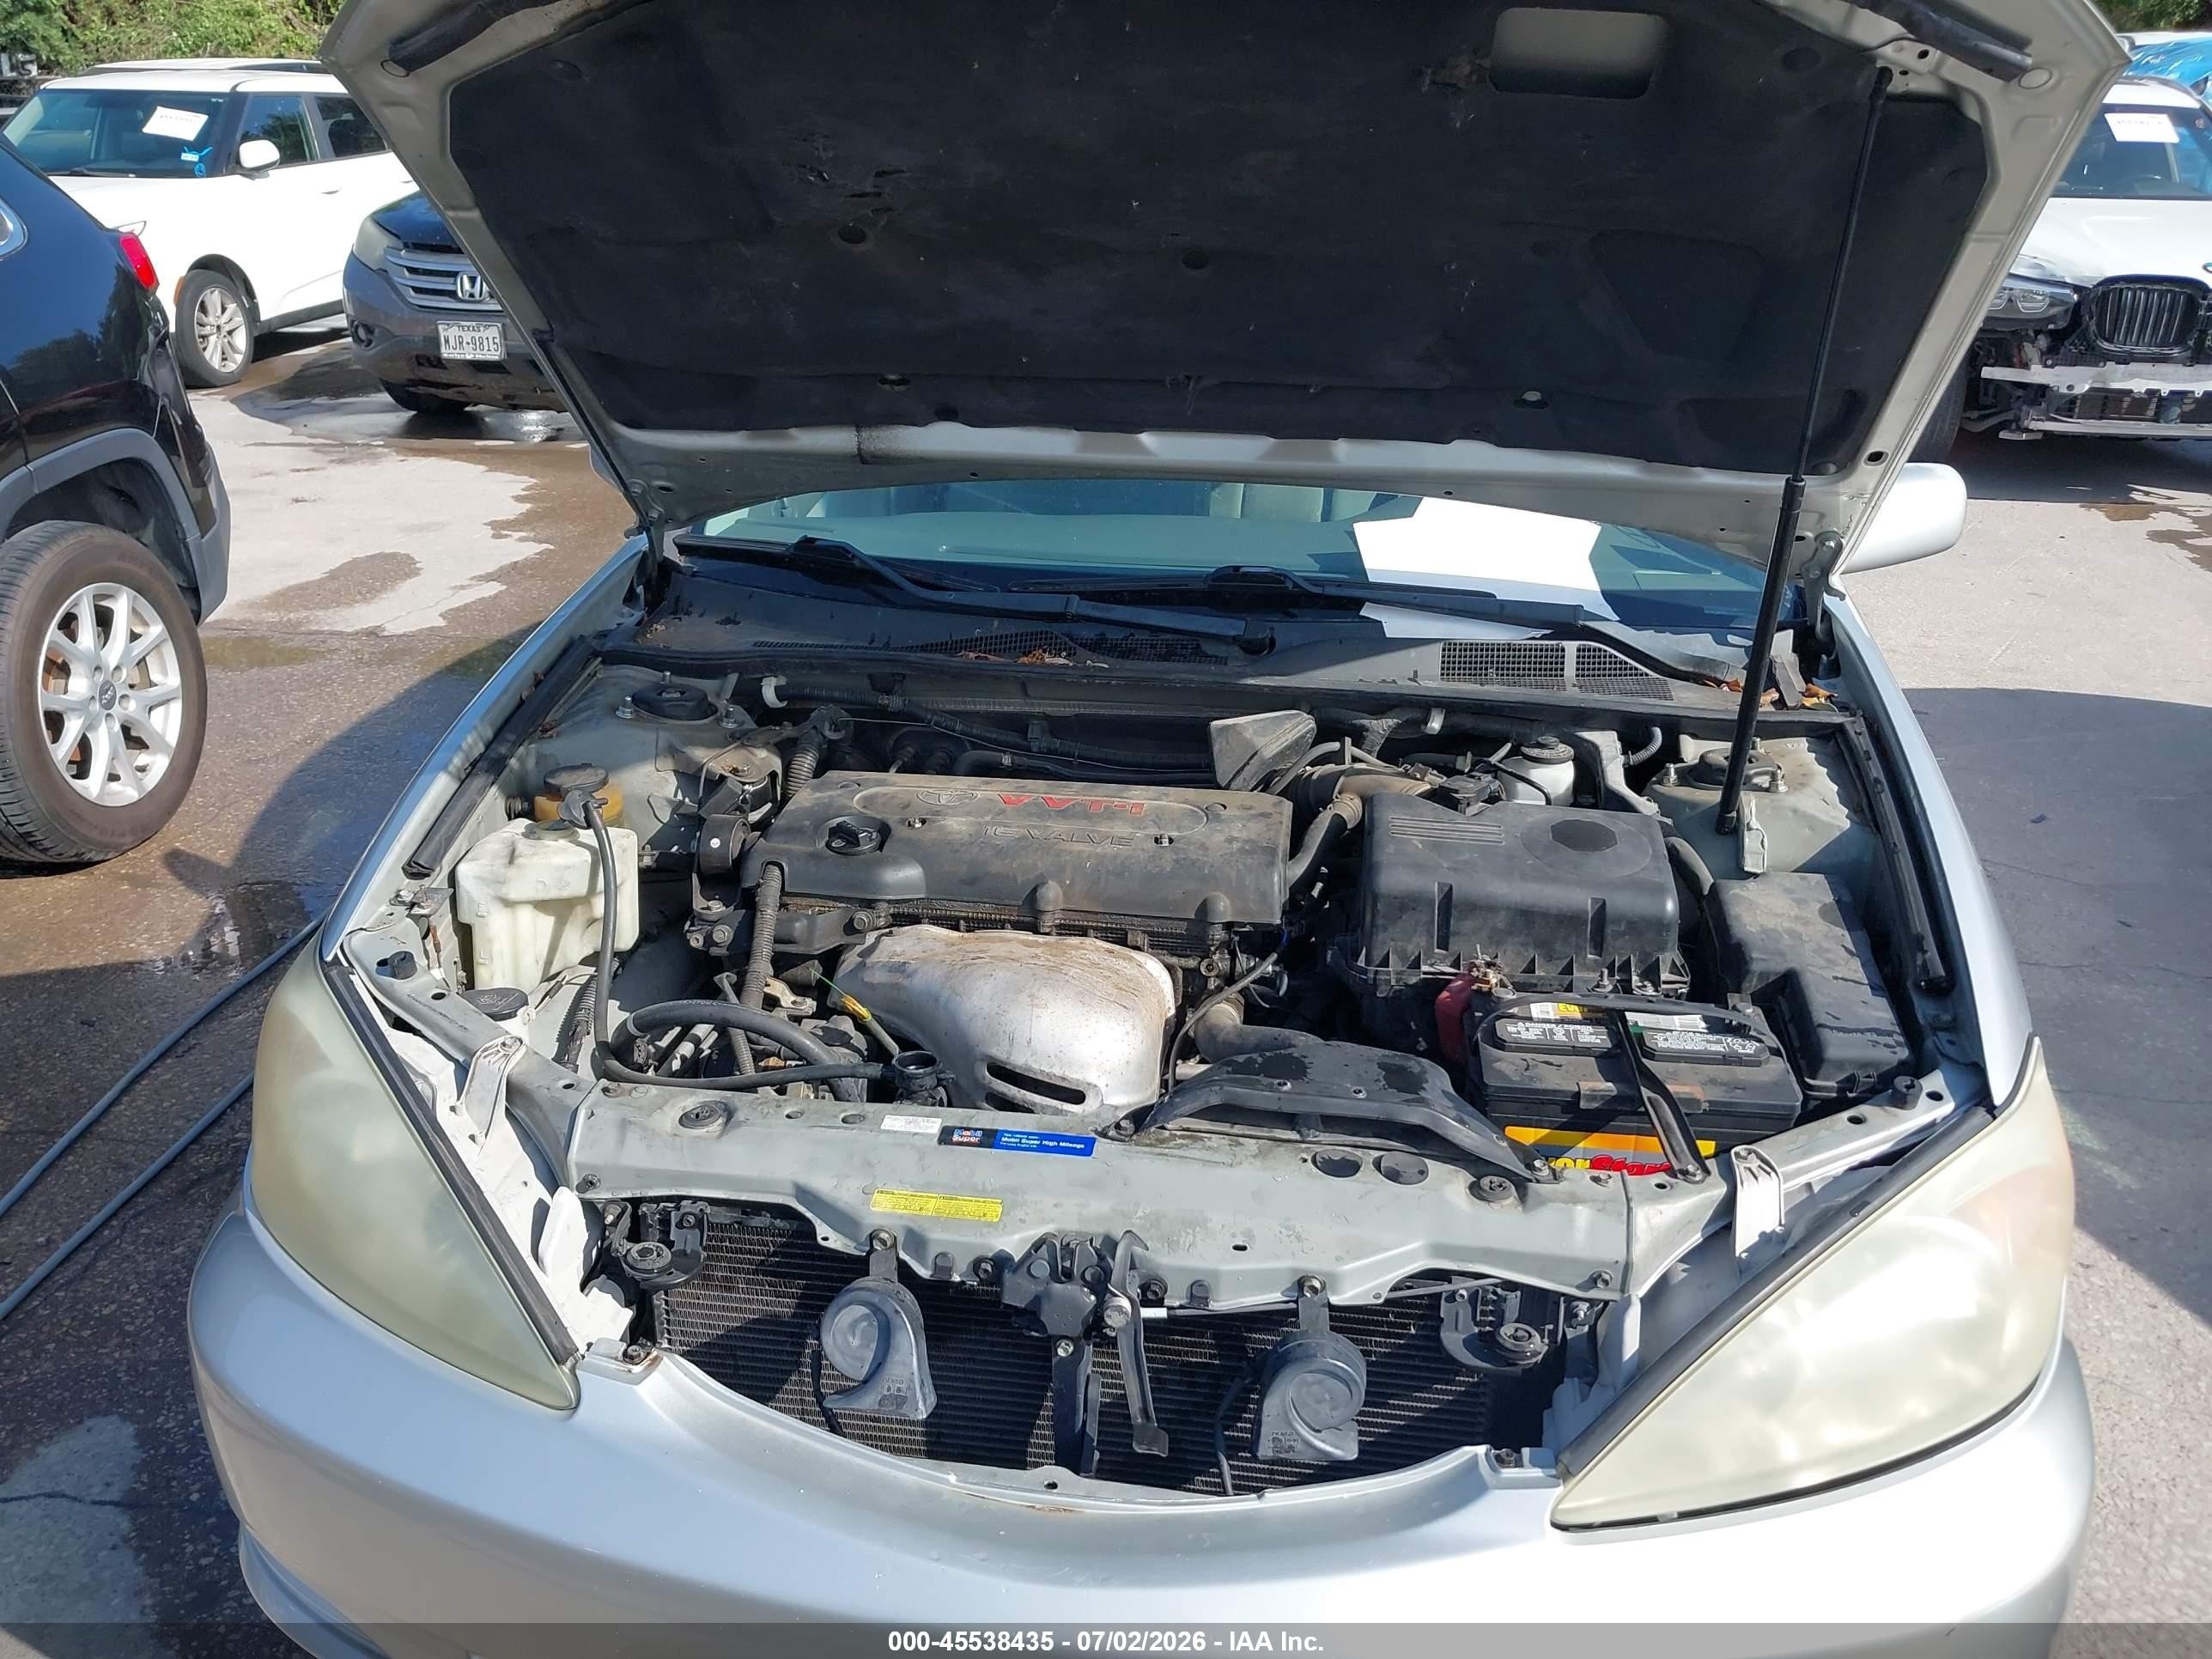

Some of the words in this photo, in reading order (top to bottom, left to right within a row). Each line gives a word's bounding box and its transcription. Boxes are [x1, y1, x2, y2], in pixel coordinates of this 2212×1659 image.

[1026, 829, 1136, 847] VALVE
[954, 1128, 983, 1137] Mobil
[952, 1133, 981, 1142] Super
